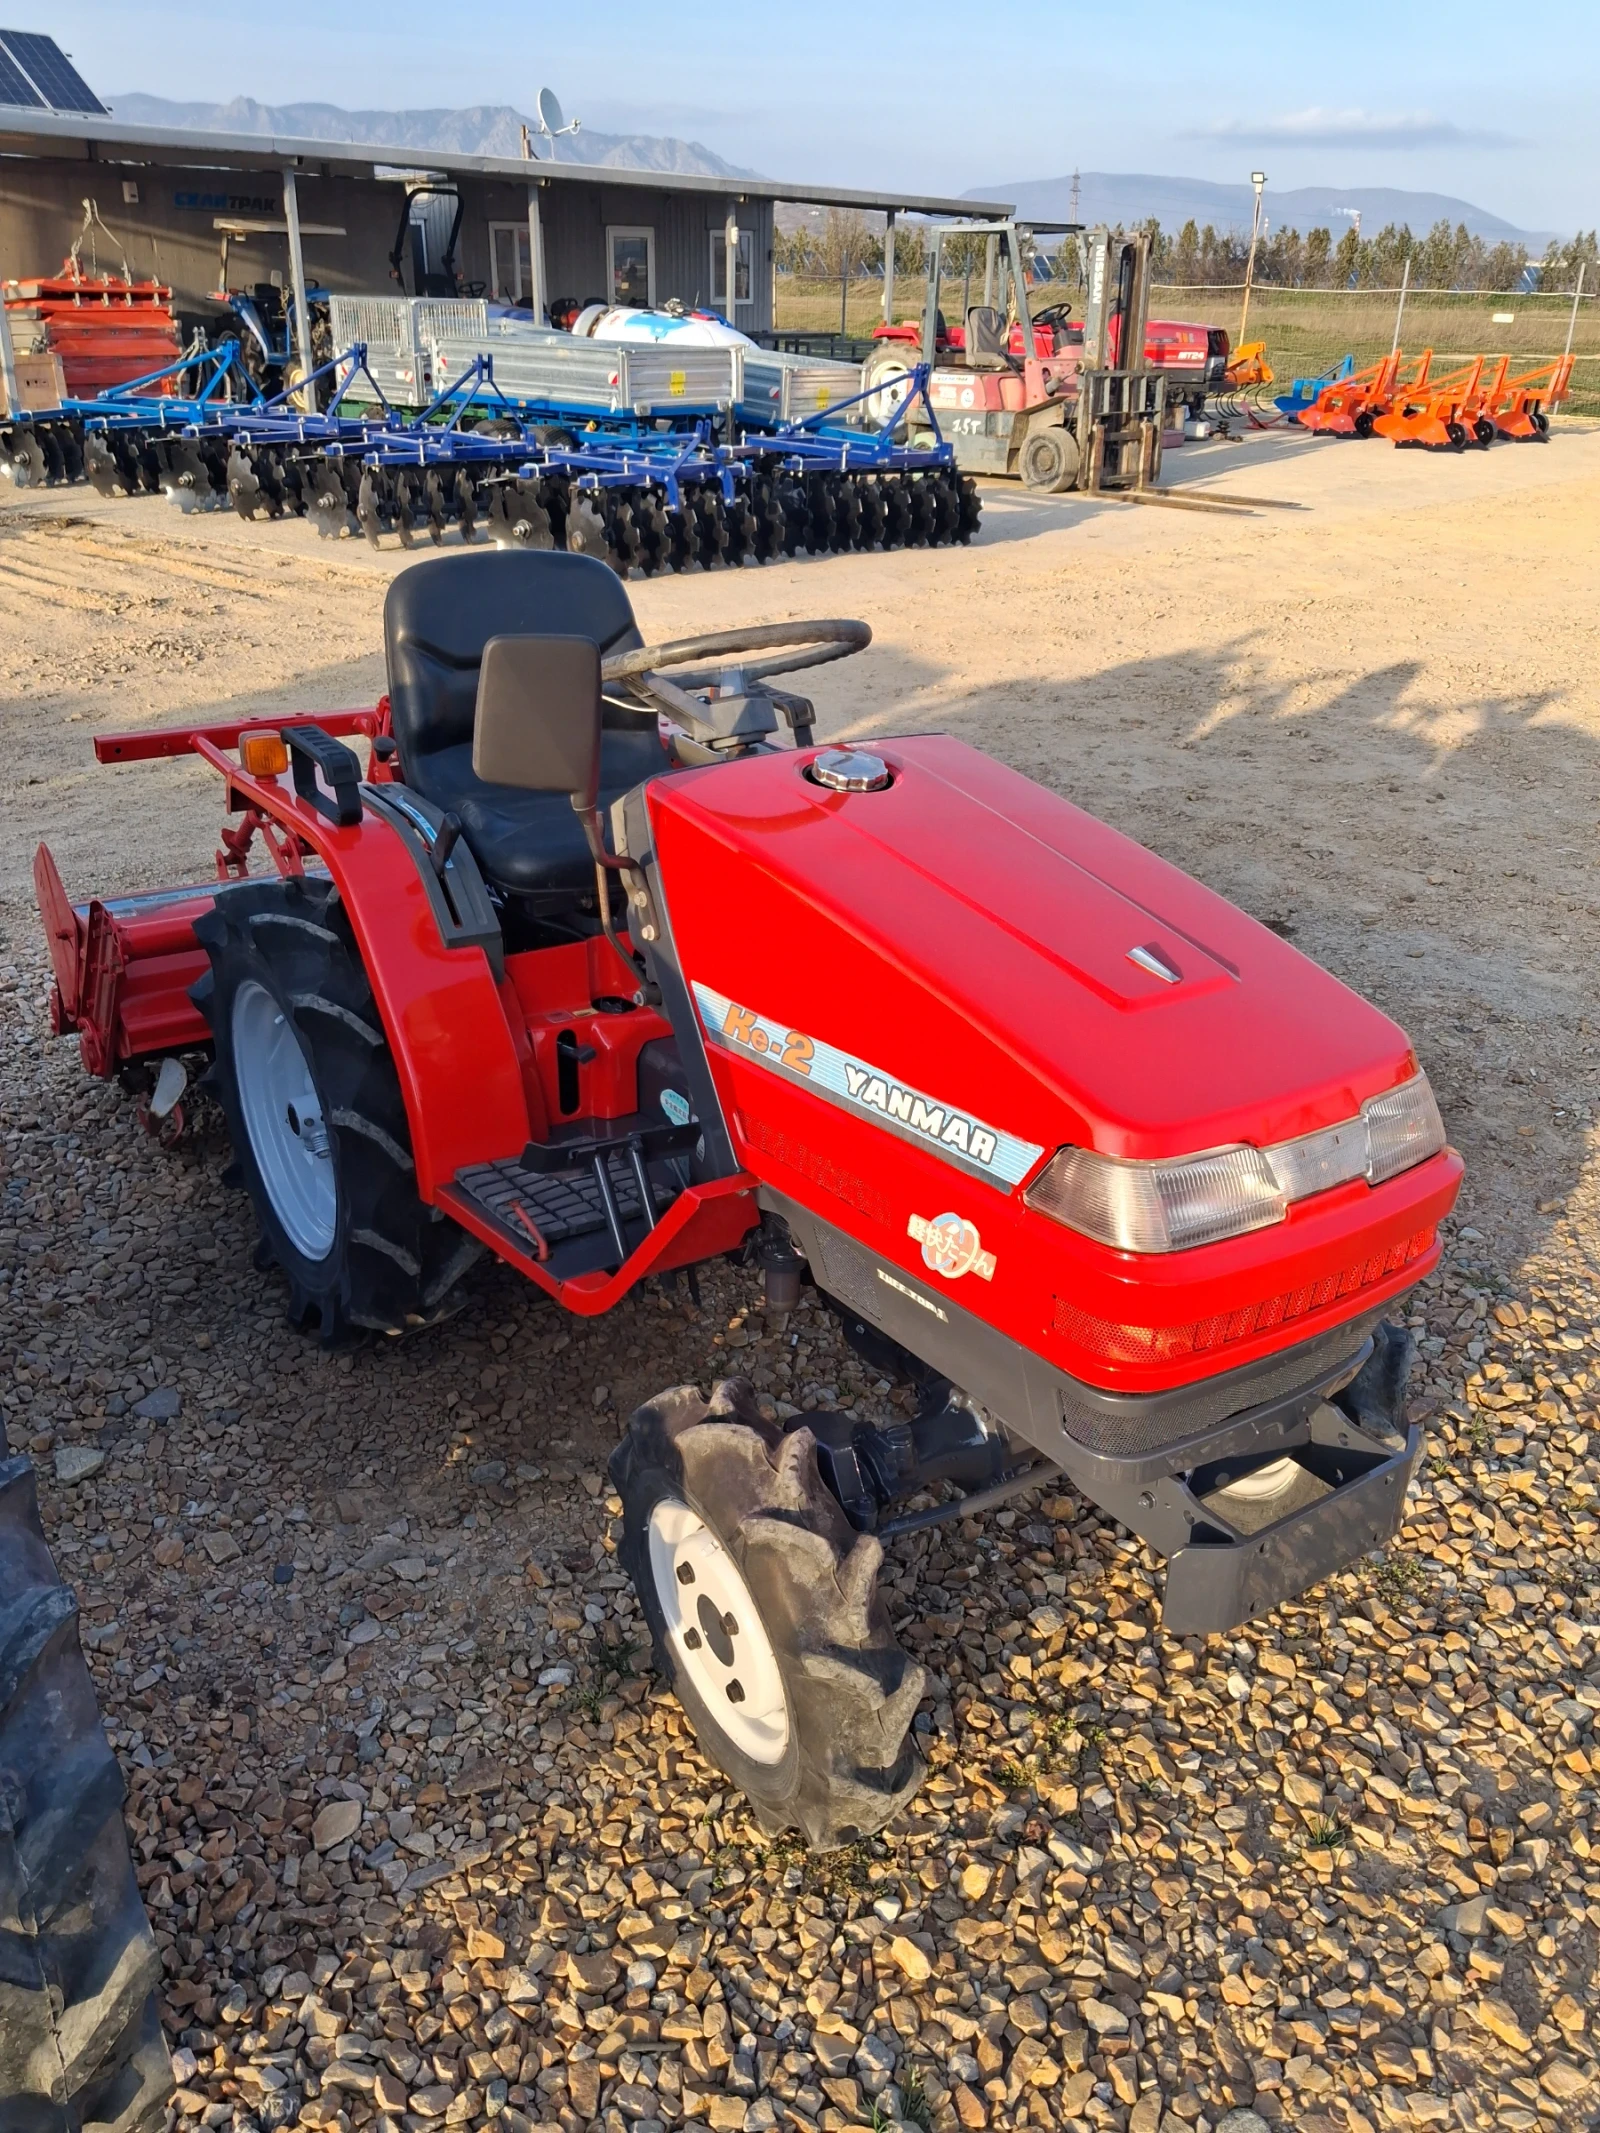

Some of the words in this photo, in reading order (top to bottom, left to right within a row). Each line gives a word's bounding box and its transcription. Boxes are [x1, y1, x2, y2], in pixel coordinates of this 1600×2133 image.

[1092, 244, 1106, 304] NISSAN
[1177, 351, 1205, 360] MT24
[721, 1004, 816, 1076] Ke-2
[844, 1063, 998, 1166] YANMAR
